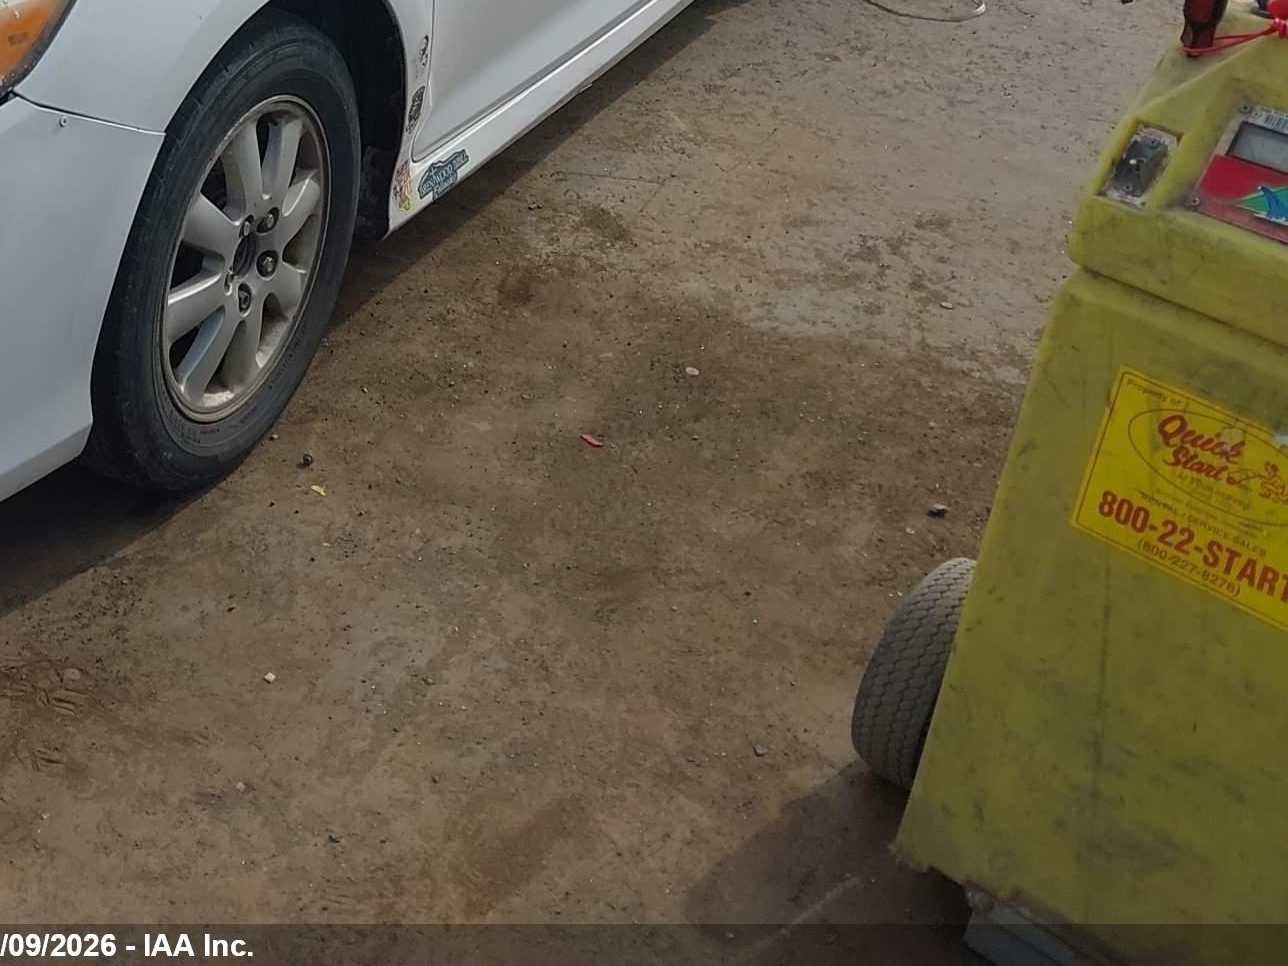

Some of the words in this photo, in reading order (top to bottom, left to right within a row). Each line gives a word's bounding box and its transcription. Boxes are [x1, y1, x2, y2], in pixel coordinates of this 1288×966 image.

[1158, 414, 1246, 464] Quick
[1162, 445, 1229, 481] Start
[1137, 538, 1241, 596] (800-227-8278)
